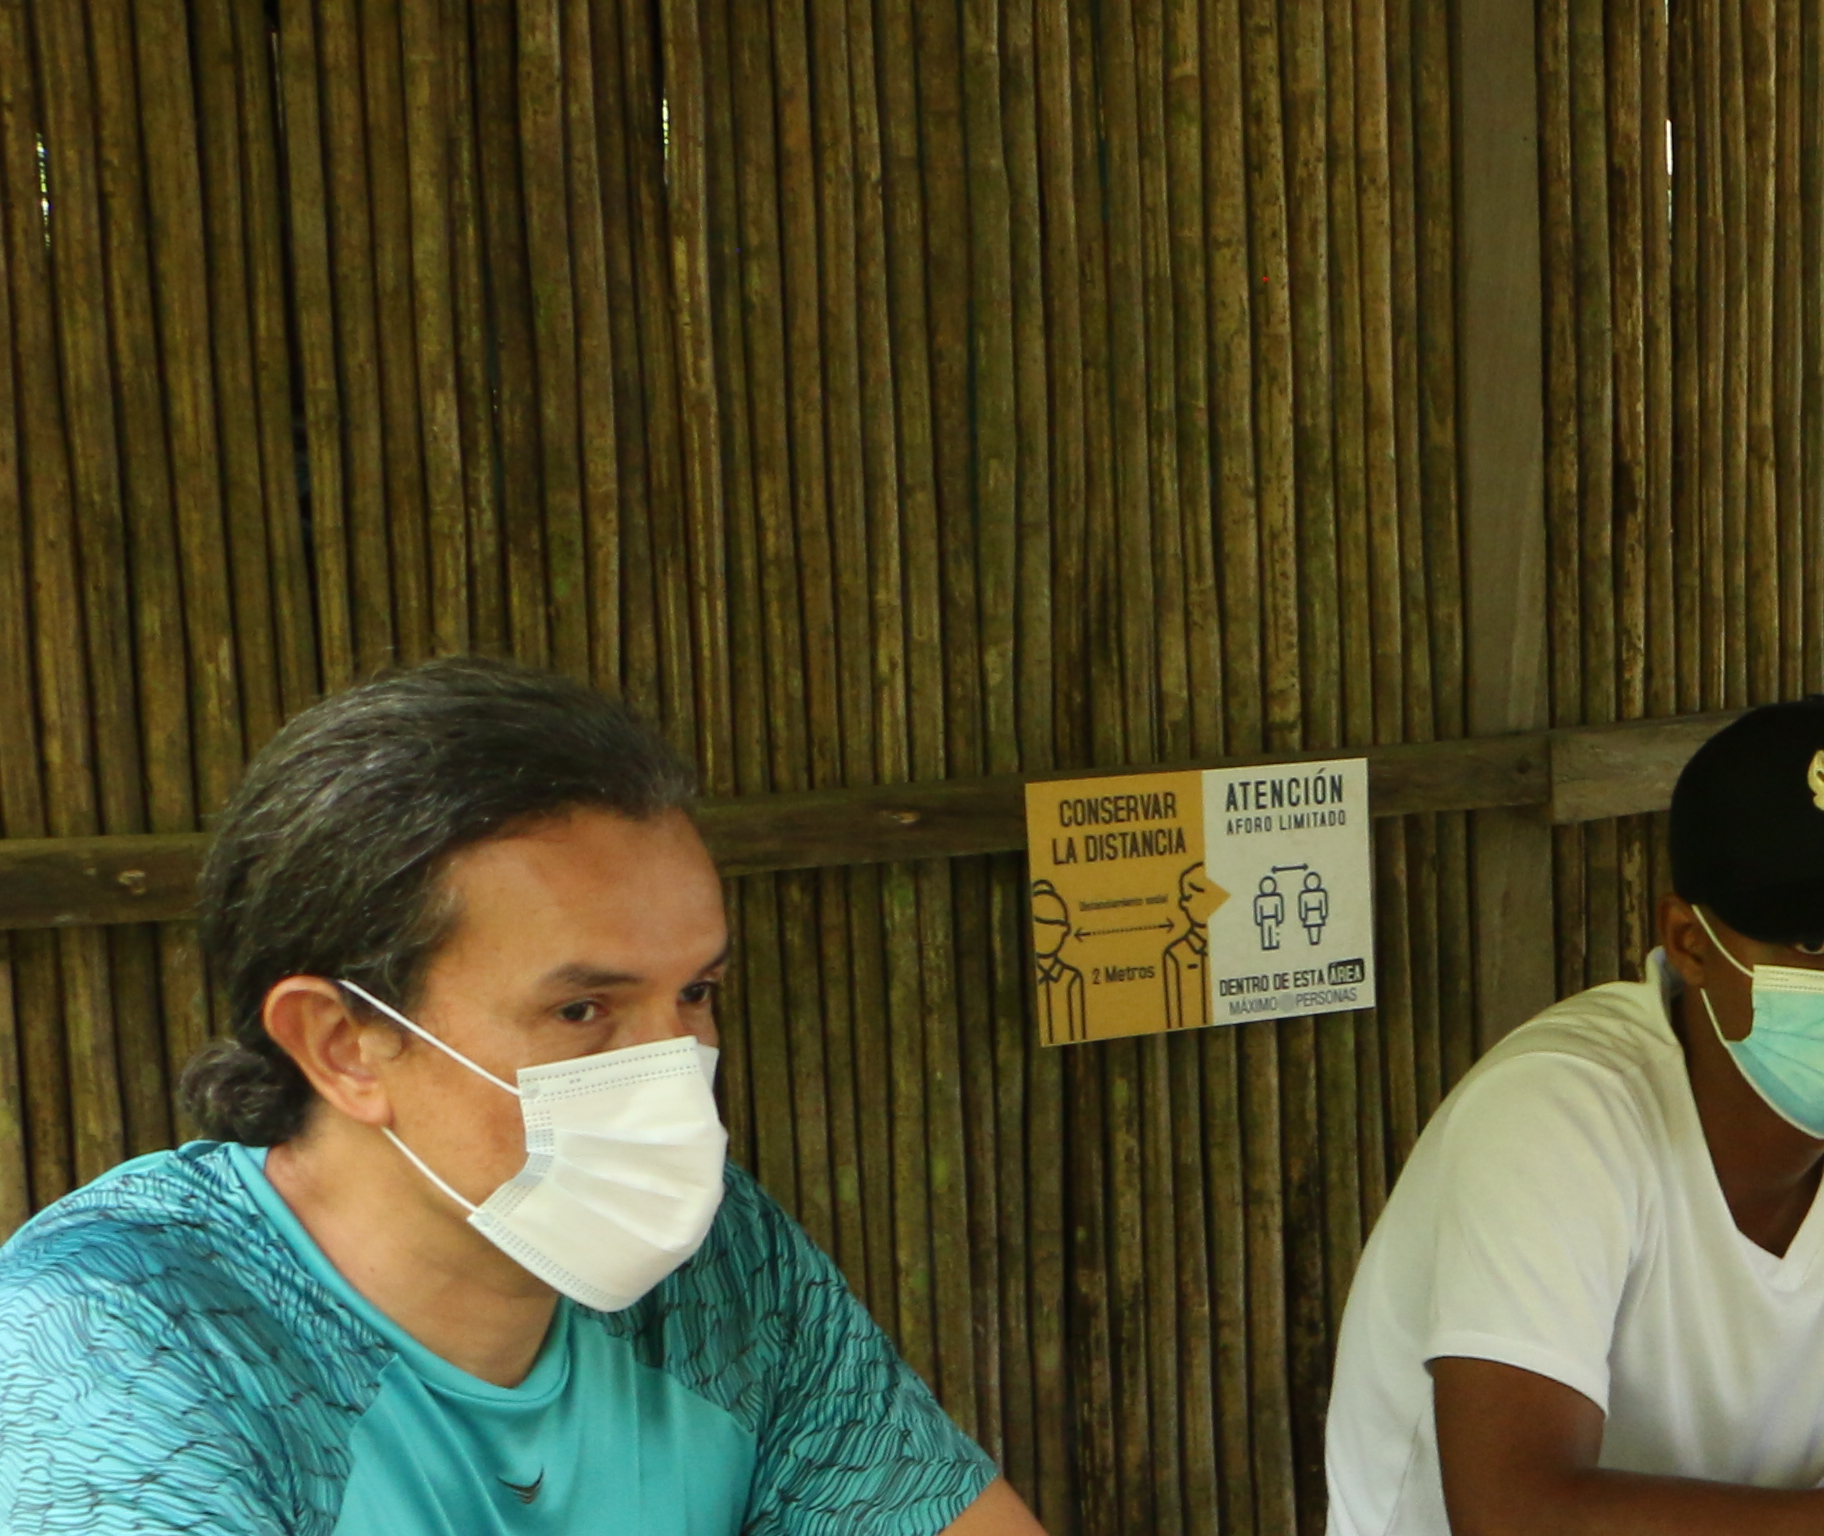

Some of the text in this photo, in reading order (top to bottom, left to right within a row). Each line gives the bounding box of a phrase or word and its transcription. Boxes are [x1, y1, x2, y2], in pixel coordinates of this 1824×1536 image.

[1226, 767, 1342, 812] ATENCIÓN
[1059, 792, 1177, 827] CONSERVAR
[1226, 809, 1346, 835] AFORO LIMITADO
[1052, 827, 1186, 865] LA DISTANCIA
[1092, 966, 1155, 985] 2 Metros
[1220, 962, 1363, 996] DENTRO DE ESTA ÁREA
[1229, 988, 1357, 1015] MÁXIMO PERSONAS
